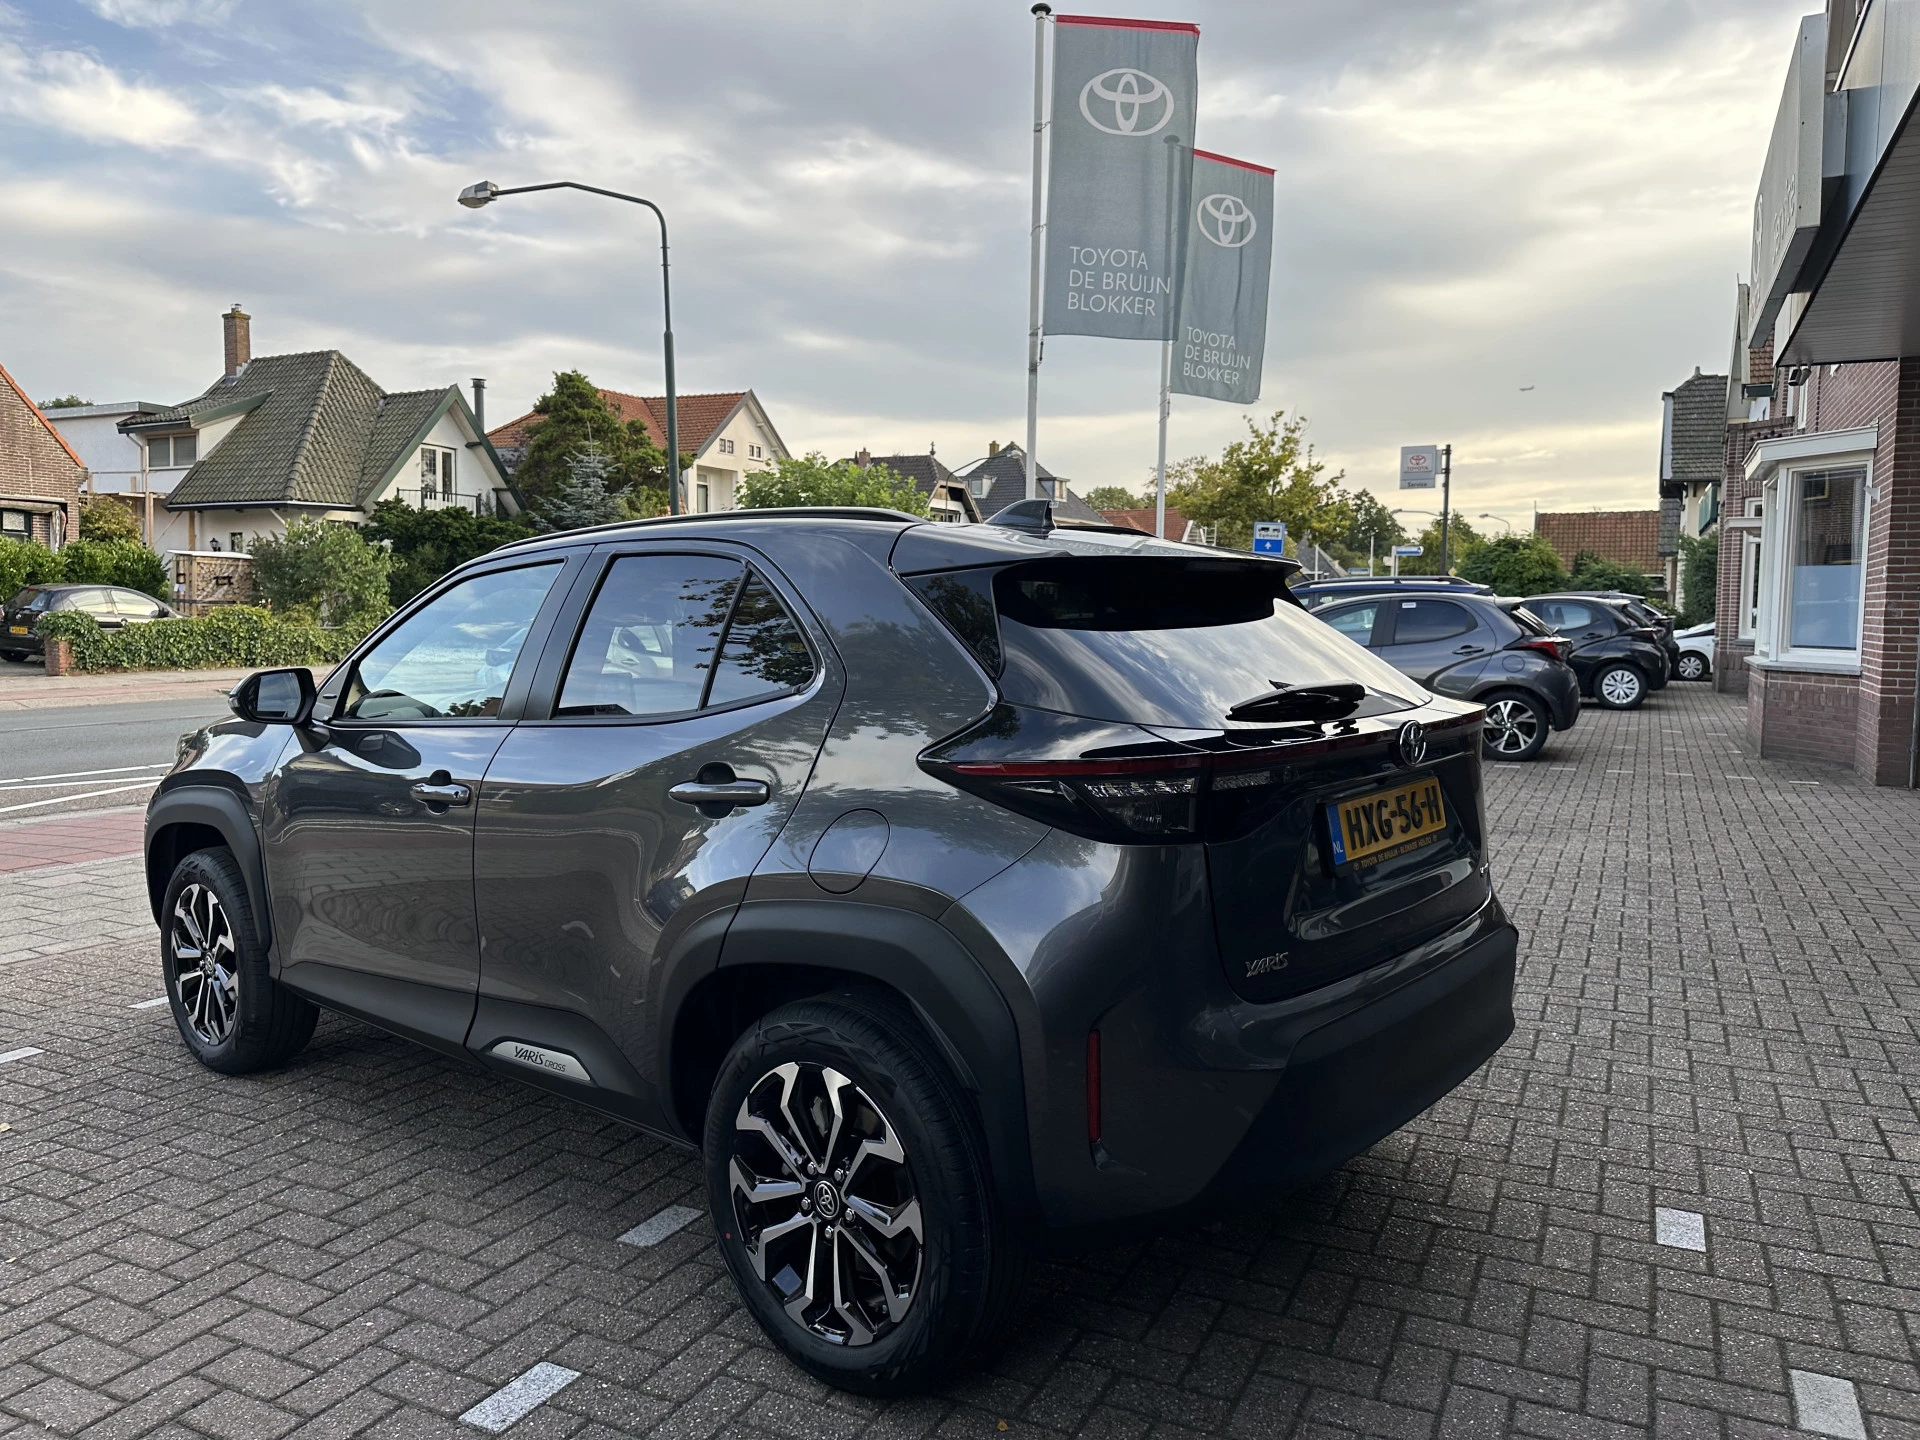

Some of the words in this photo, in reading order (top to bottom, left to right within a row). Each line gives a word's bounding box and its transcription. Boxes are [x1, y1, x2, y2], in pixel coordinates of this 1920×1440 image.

[1069, 246, 1148, 270] TOYOTA
[1069, 269, 1095, 289] DE
[1102, 272, 1171, 294] BRUIJN
[1068, 291, 1156, 316] BLOKKER
[1186, 326, 1236, 350] TOYOTA
[1184, 344, 1201, 360] DE
[1203, 349, 1251, 370] BRUIJN
[1183, 362, 1240, 385] BLOKKER
[1345, 785, 1442, 851] HXG-56-H
[1333, 841, 1344, 854] NL
[544, 1059, 567, 1073] CROSS
